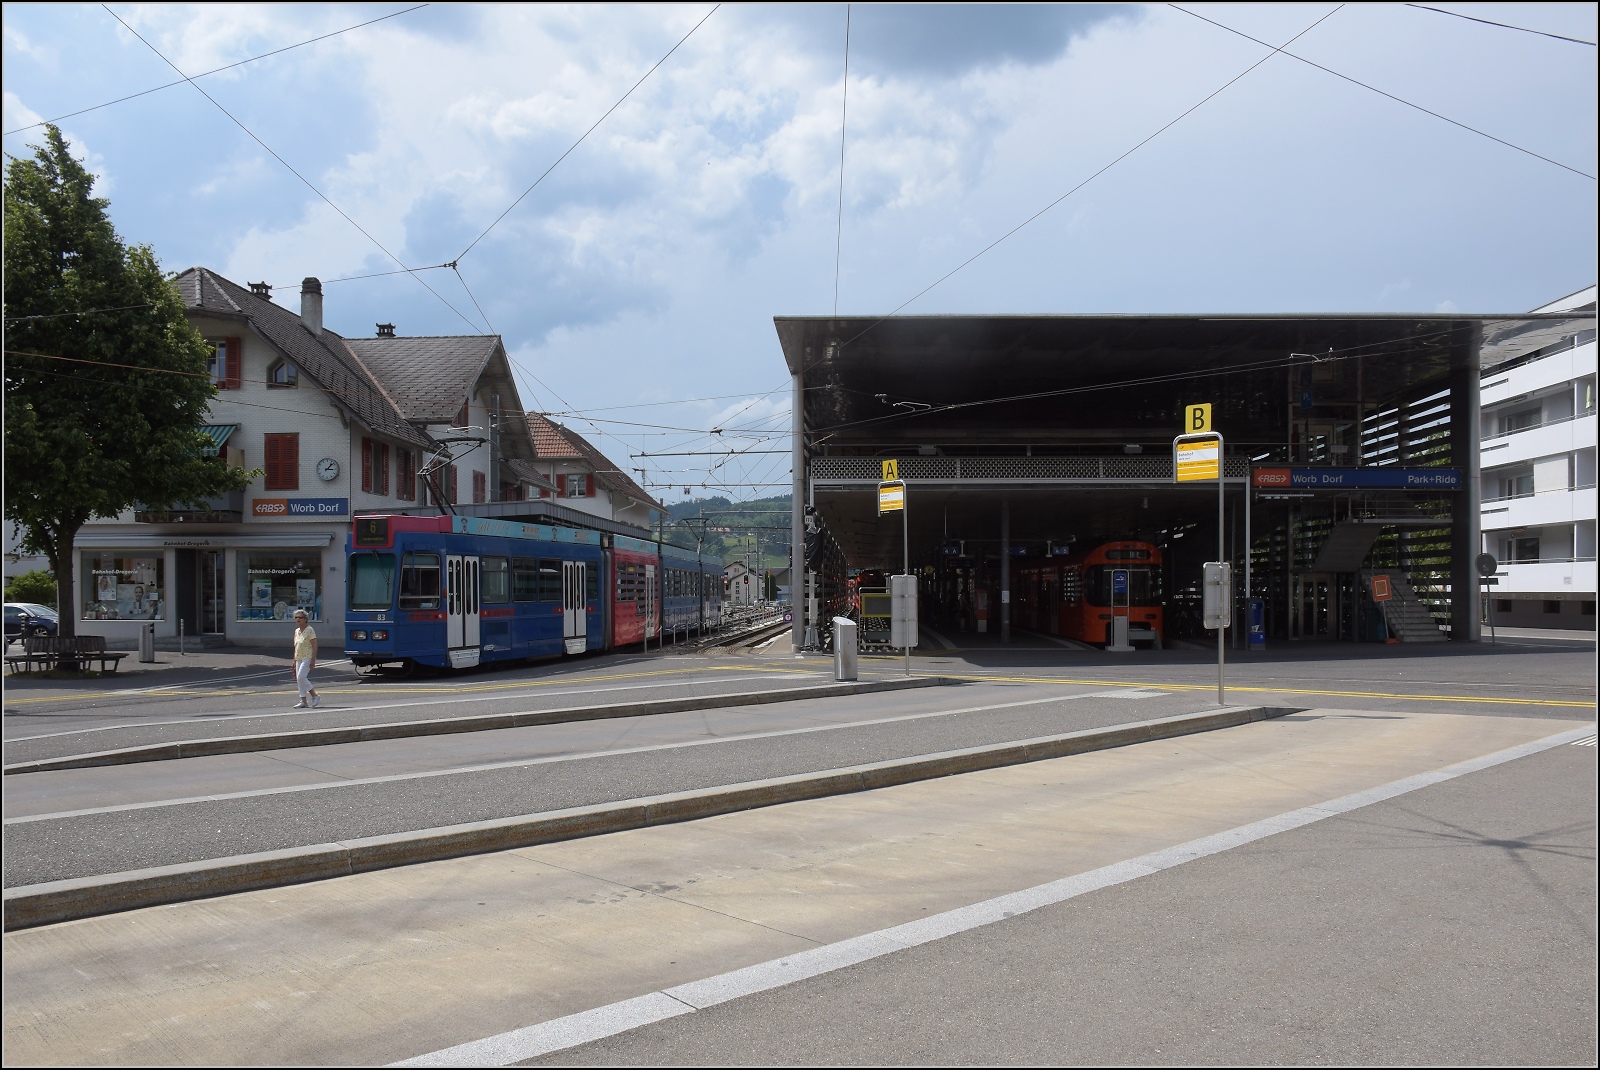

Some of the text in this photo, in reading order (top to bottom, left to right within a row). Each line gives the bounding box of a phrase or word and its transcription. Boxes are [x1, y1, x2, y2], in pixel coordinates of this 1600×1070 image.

[1192, 407, 1205, 431] B
[886, 462, 895, 479] A
[1260, 474, 1343, 483] RBS Worb Dorf
[1408, 475, 1456, 484] Park+Ride
[258, 504, 339, 512] RBS Worb Dorf
[370, 520, 376, 534] 6
